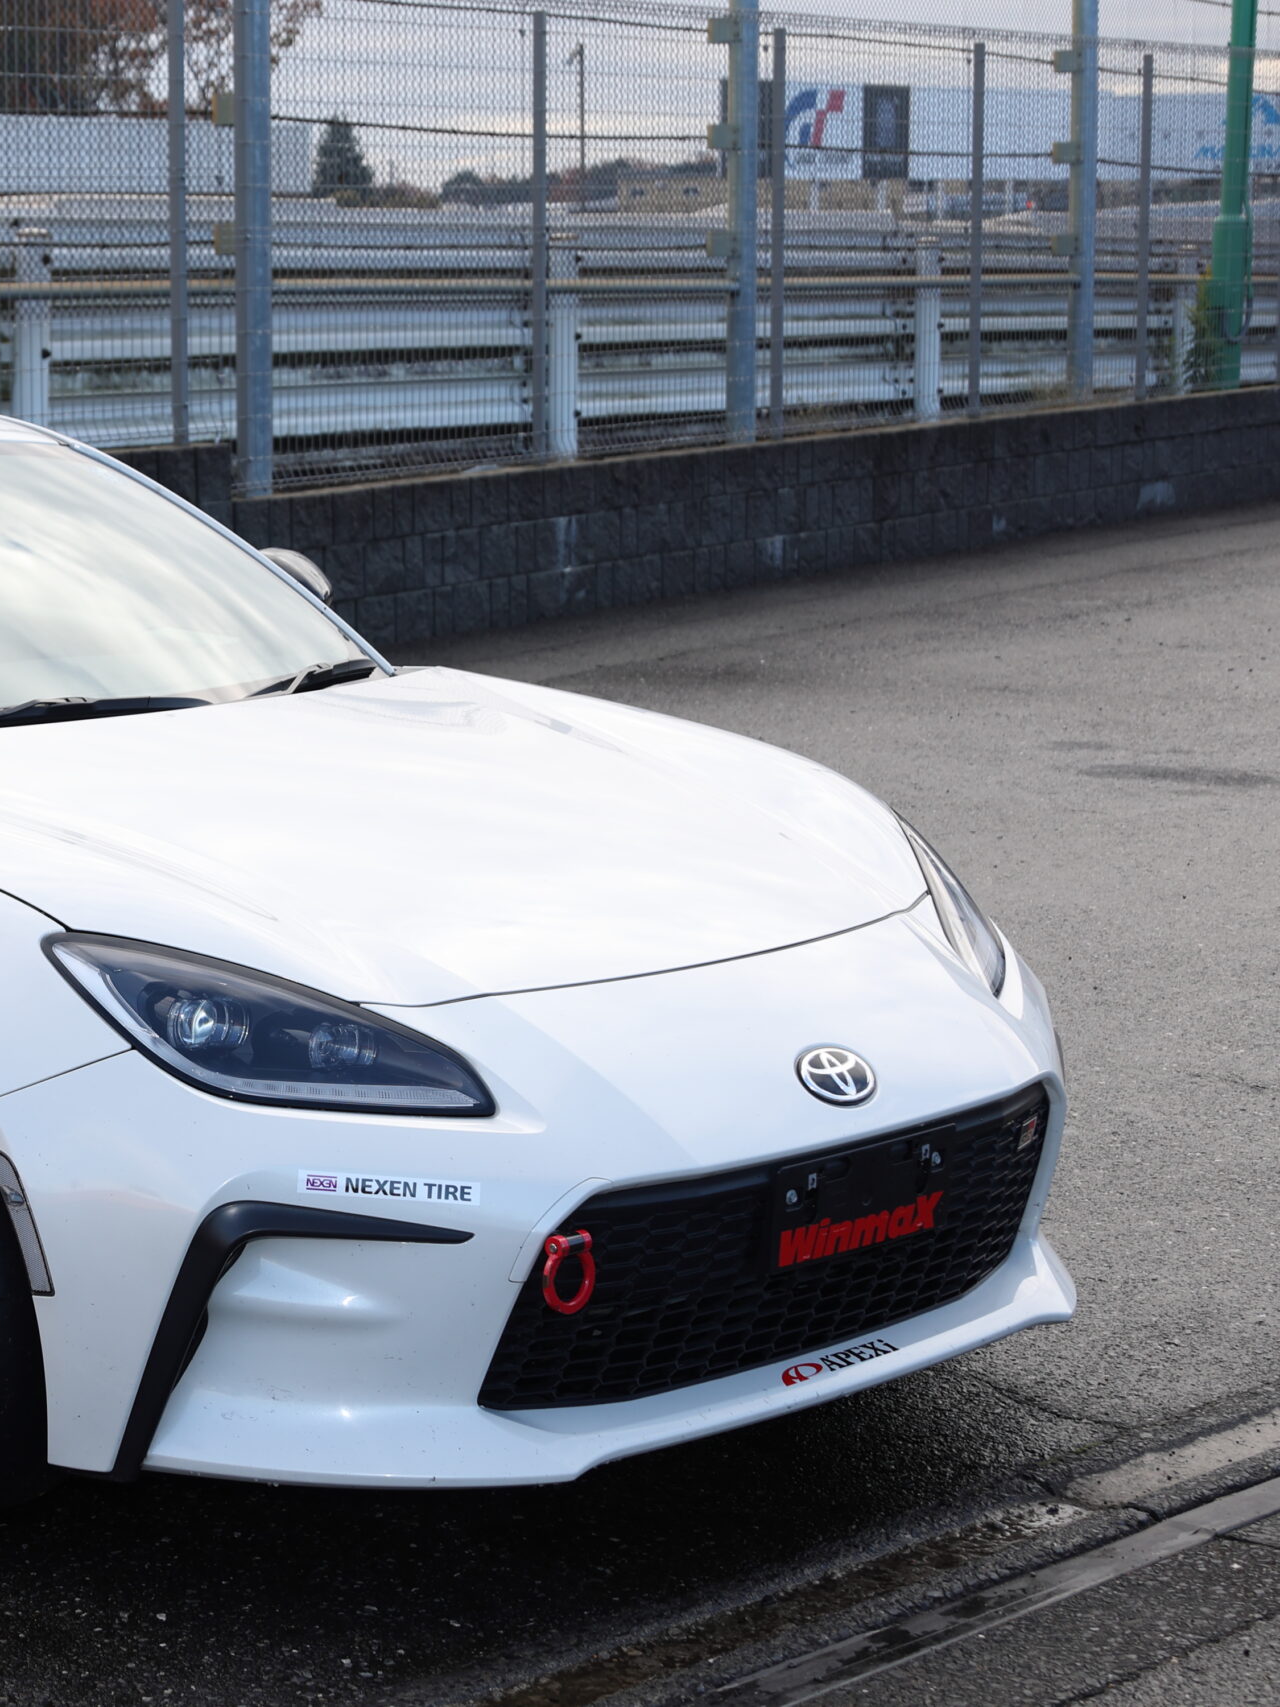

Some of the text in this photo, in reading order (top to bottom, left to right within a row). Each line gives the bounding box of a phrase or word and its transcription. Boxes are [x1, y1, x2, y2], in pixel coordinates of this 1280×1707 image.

[306, 1176, 472, 1202] NEXEN NEXEN TIRE
